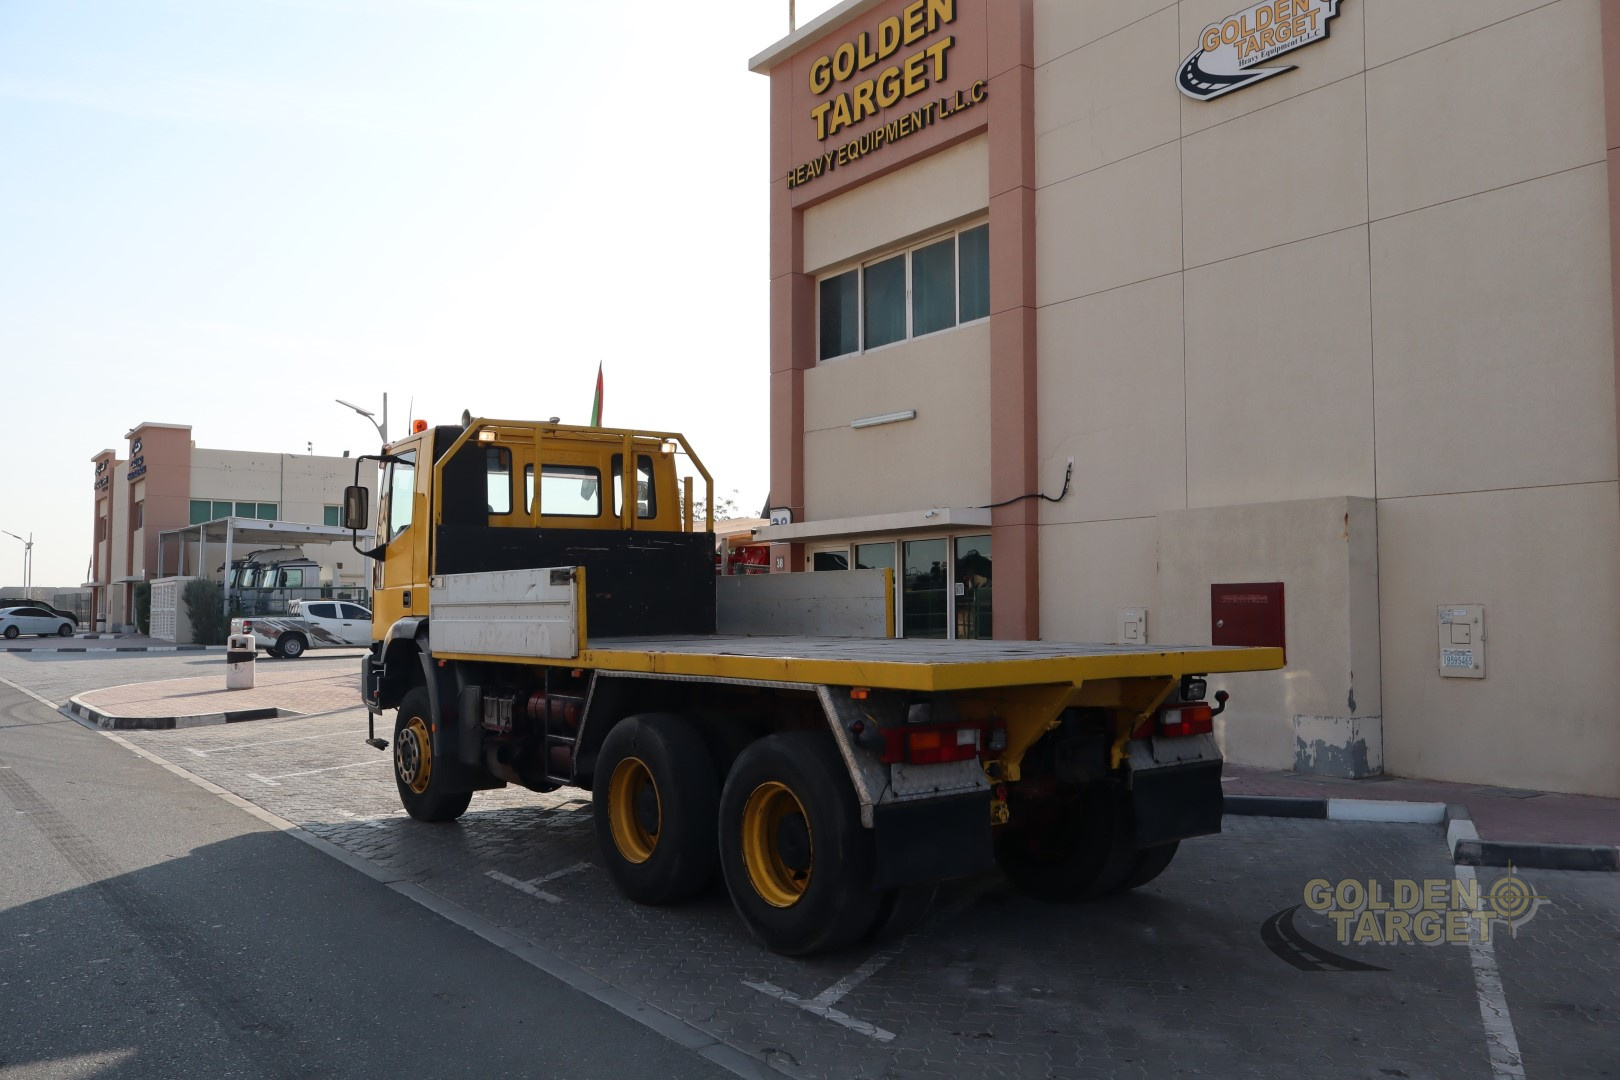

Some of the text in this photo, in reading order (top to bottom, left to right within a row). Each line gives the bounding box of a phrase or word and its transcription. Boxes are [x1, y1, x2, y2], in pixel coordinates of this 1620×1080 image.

[808, 0, 955, 95] GOLDEN
[1203, 0, 1309, 52] GOLDEN
[1234, 8, 1320, 60] TARGET
[1238, 54, 1259, 67] Heavy
[1261, 39, 1298, 58] Equipment
[811, 36, 953, 141] TARGET
[786, 80, 987, 188] HEAVY EQUIPMENT L.L.C
